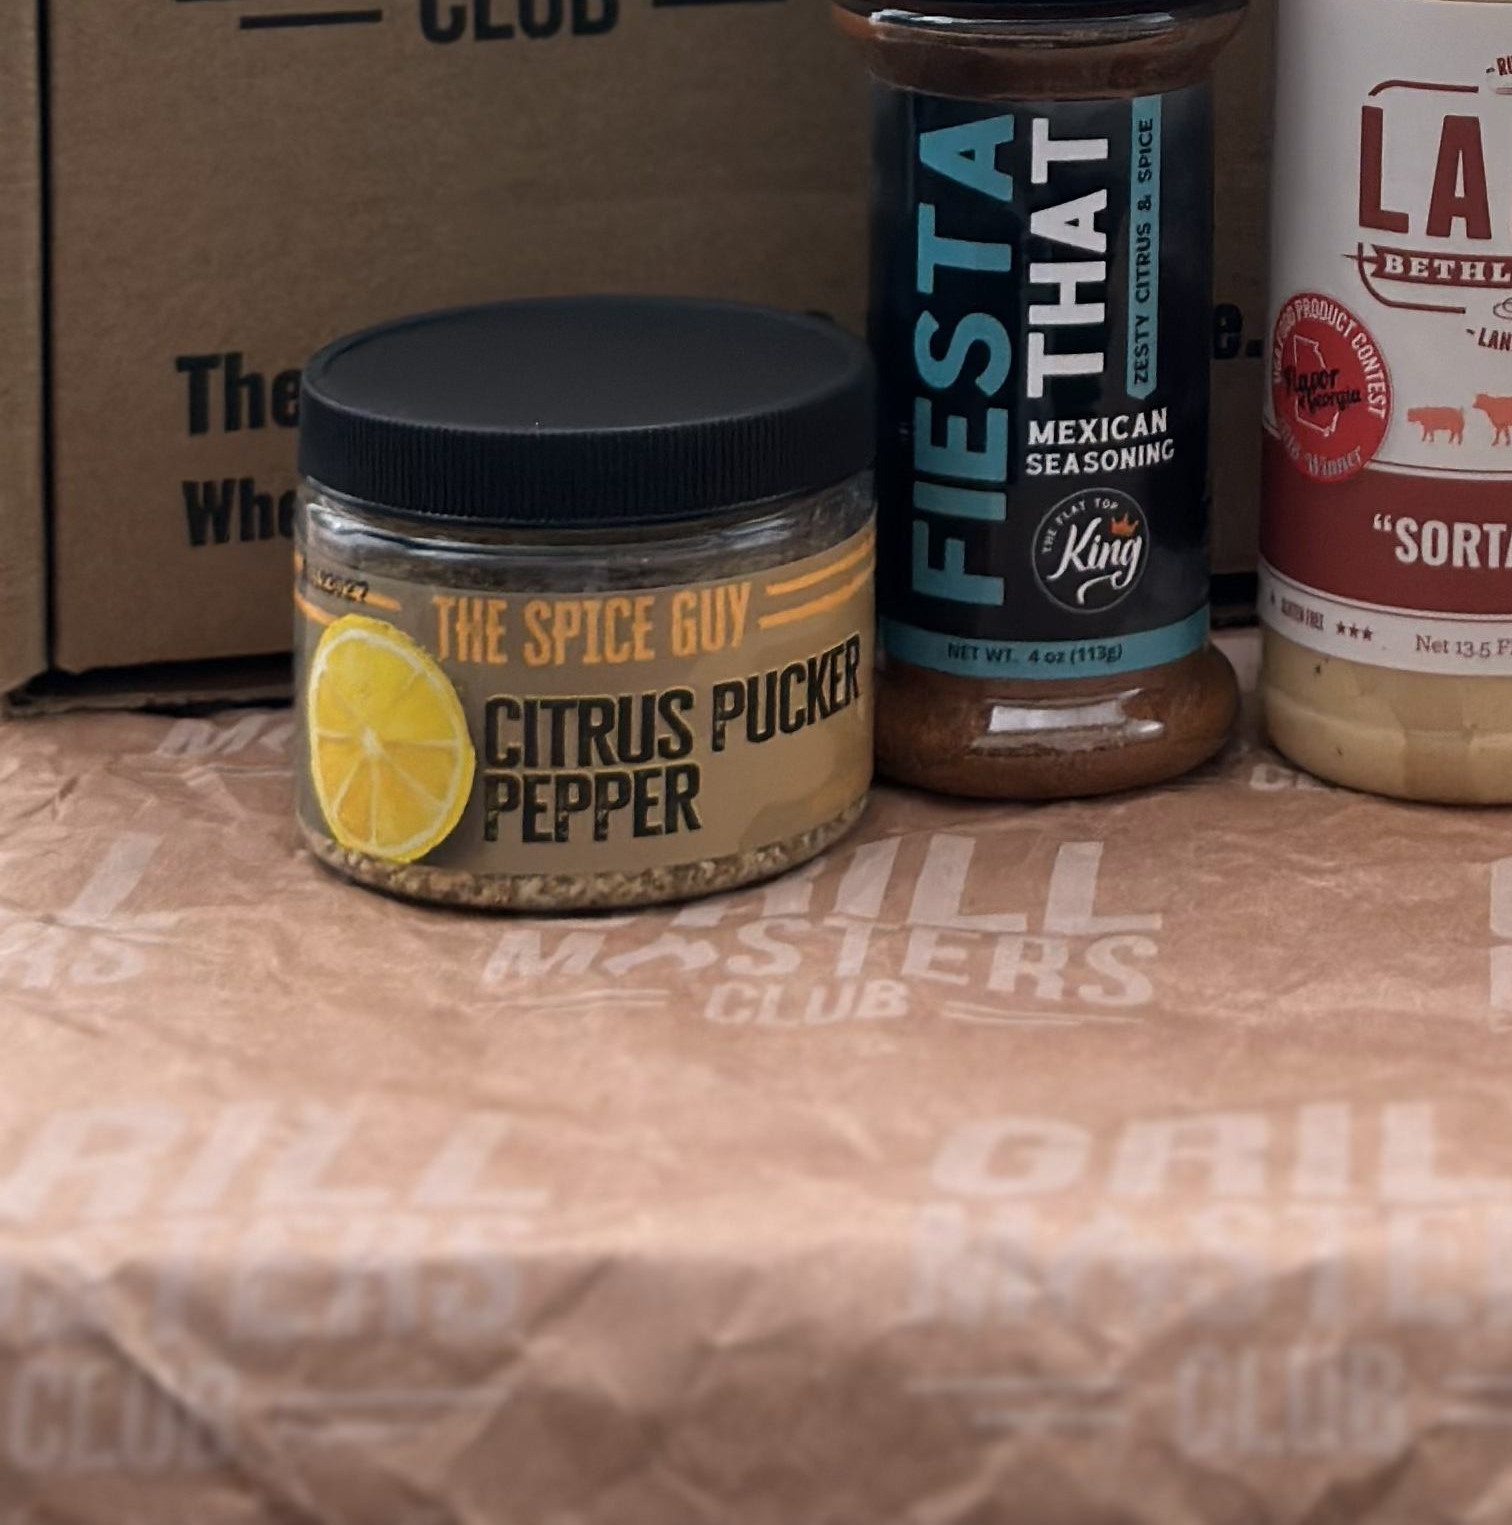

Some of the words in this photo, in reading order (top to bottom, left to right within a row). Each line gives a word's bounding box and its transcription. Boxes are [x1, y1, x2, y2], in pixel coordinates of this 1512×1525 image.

[1138, 119, 1154, 184] SPICE
[1138, 194, 1152, 211] &
[1026, 117, 1109, 399] THAT
[1135, 217, 1151, 303] CITRUS
[912, 114, 1016, 607] FIESTA
[1133, 314, 1150, 385] ZESTY
[1351, 332, 1388, 420] CONTEST
[1025, 438, 1175, 476] SEASONING
[1027, 406, 1169, 446] MEXICAN
[1046, 516, 1143, 605] King
[431, 595, 508, 667] THE
[524, 592, 655, 670] SPICE
[671, 581, 753, 659] GUY
[948, 642, 980, 661] NET
[1028, 649, 1040, 663] 4
[1044, 651, 1065, 663] oz
[1070, 644, 1123, 665] (113g)
[1415, 634, 1450, 654] Net
[484, 688, 696, 769] CITRUS
[711, 633, 862, 752] PUCKER
[484, 762, 703, 845] PEPPER
[482, 917, 1160, 1007] MASTERS
[703, 979, 912, 1027] CLUB
[1172, 1345, 1410, 1461] CLUB
